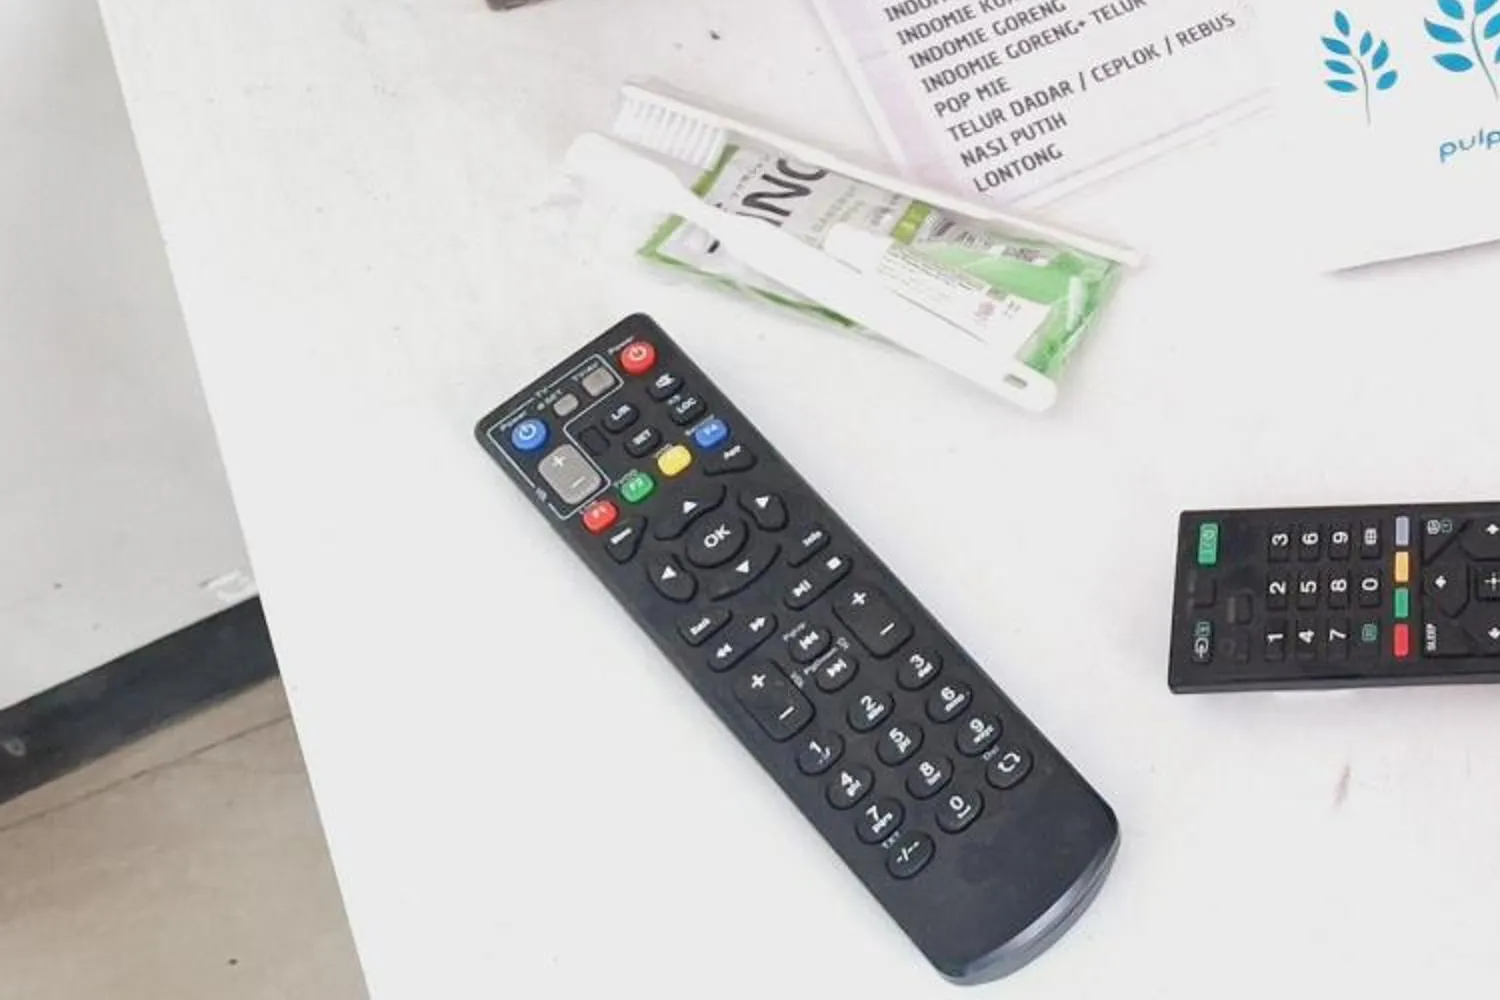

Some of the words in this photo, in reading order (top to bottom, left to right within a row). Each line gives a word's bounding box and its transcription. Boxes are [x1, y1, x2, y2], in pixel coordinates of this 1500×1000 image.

[897, 5, 975, 45] INDOMIE
[909, 27, 987, 68] INDOMIE
[921, 51, 1001, 92] INDOMIE
[947, 108, 1007, 141] TELUR
[1009, 80, 1073, 117] DADAR
[1090, 44, 1160, 82] CEPLOK
[1175, 13, 1235, 46] REBUS
[933, 91, 971, 117] POP
[975, 77, 1010, 101] MIE
[960, 137, 1008, 167] NASI
[1010, 112, 1067, 146] PUTIH
[973, 144, 1062, 192] LONTONG
[704, 524, 731, 548] OK
[1272, 533, 1289, 546] 3
[1302, 532, 1318, 545] 6
[1332, 531, 1348, 544] 9
[1269, 581, 1287, 594] 2
[1300, 580, 1317, 593] 5
[1331, 578, 1347, 591] 8
[1362, 577, 1378, 591] 0
[1267, 632, 1284, 645] 1
[1298, 629, 1315, 643] 4
[1329, 628, 1347, 641] 7
[909, 654, 924, 669] 3
[940, 687, 956, 701] 6
[861, 696, 877, 711] 2
[969, 719, 985, 734] 9
[889, 728, 905, 743] 5
[809, 741, 823, 755] 1
[919, 762, 935, 777] 8
[841, 771, 854, 787] 4
[949, 795, 965, 811] 0
[865, 805, 880, 822] 7
